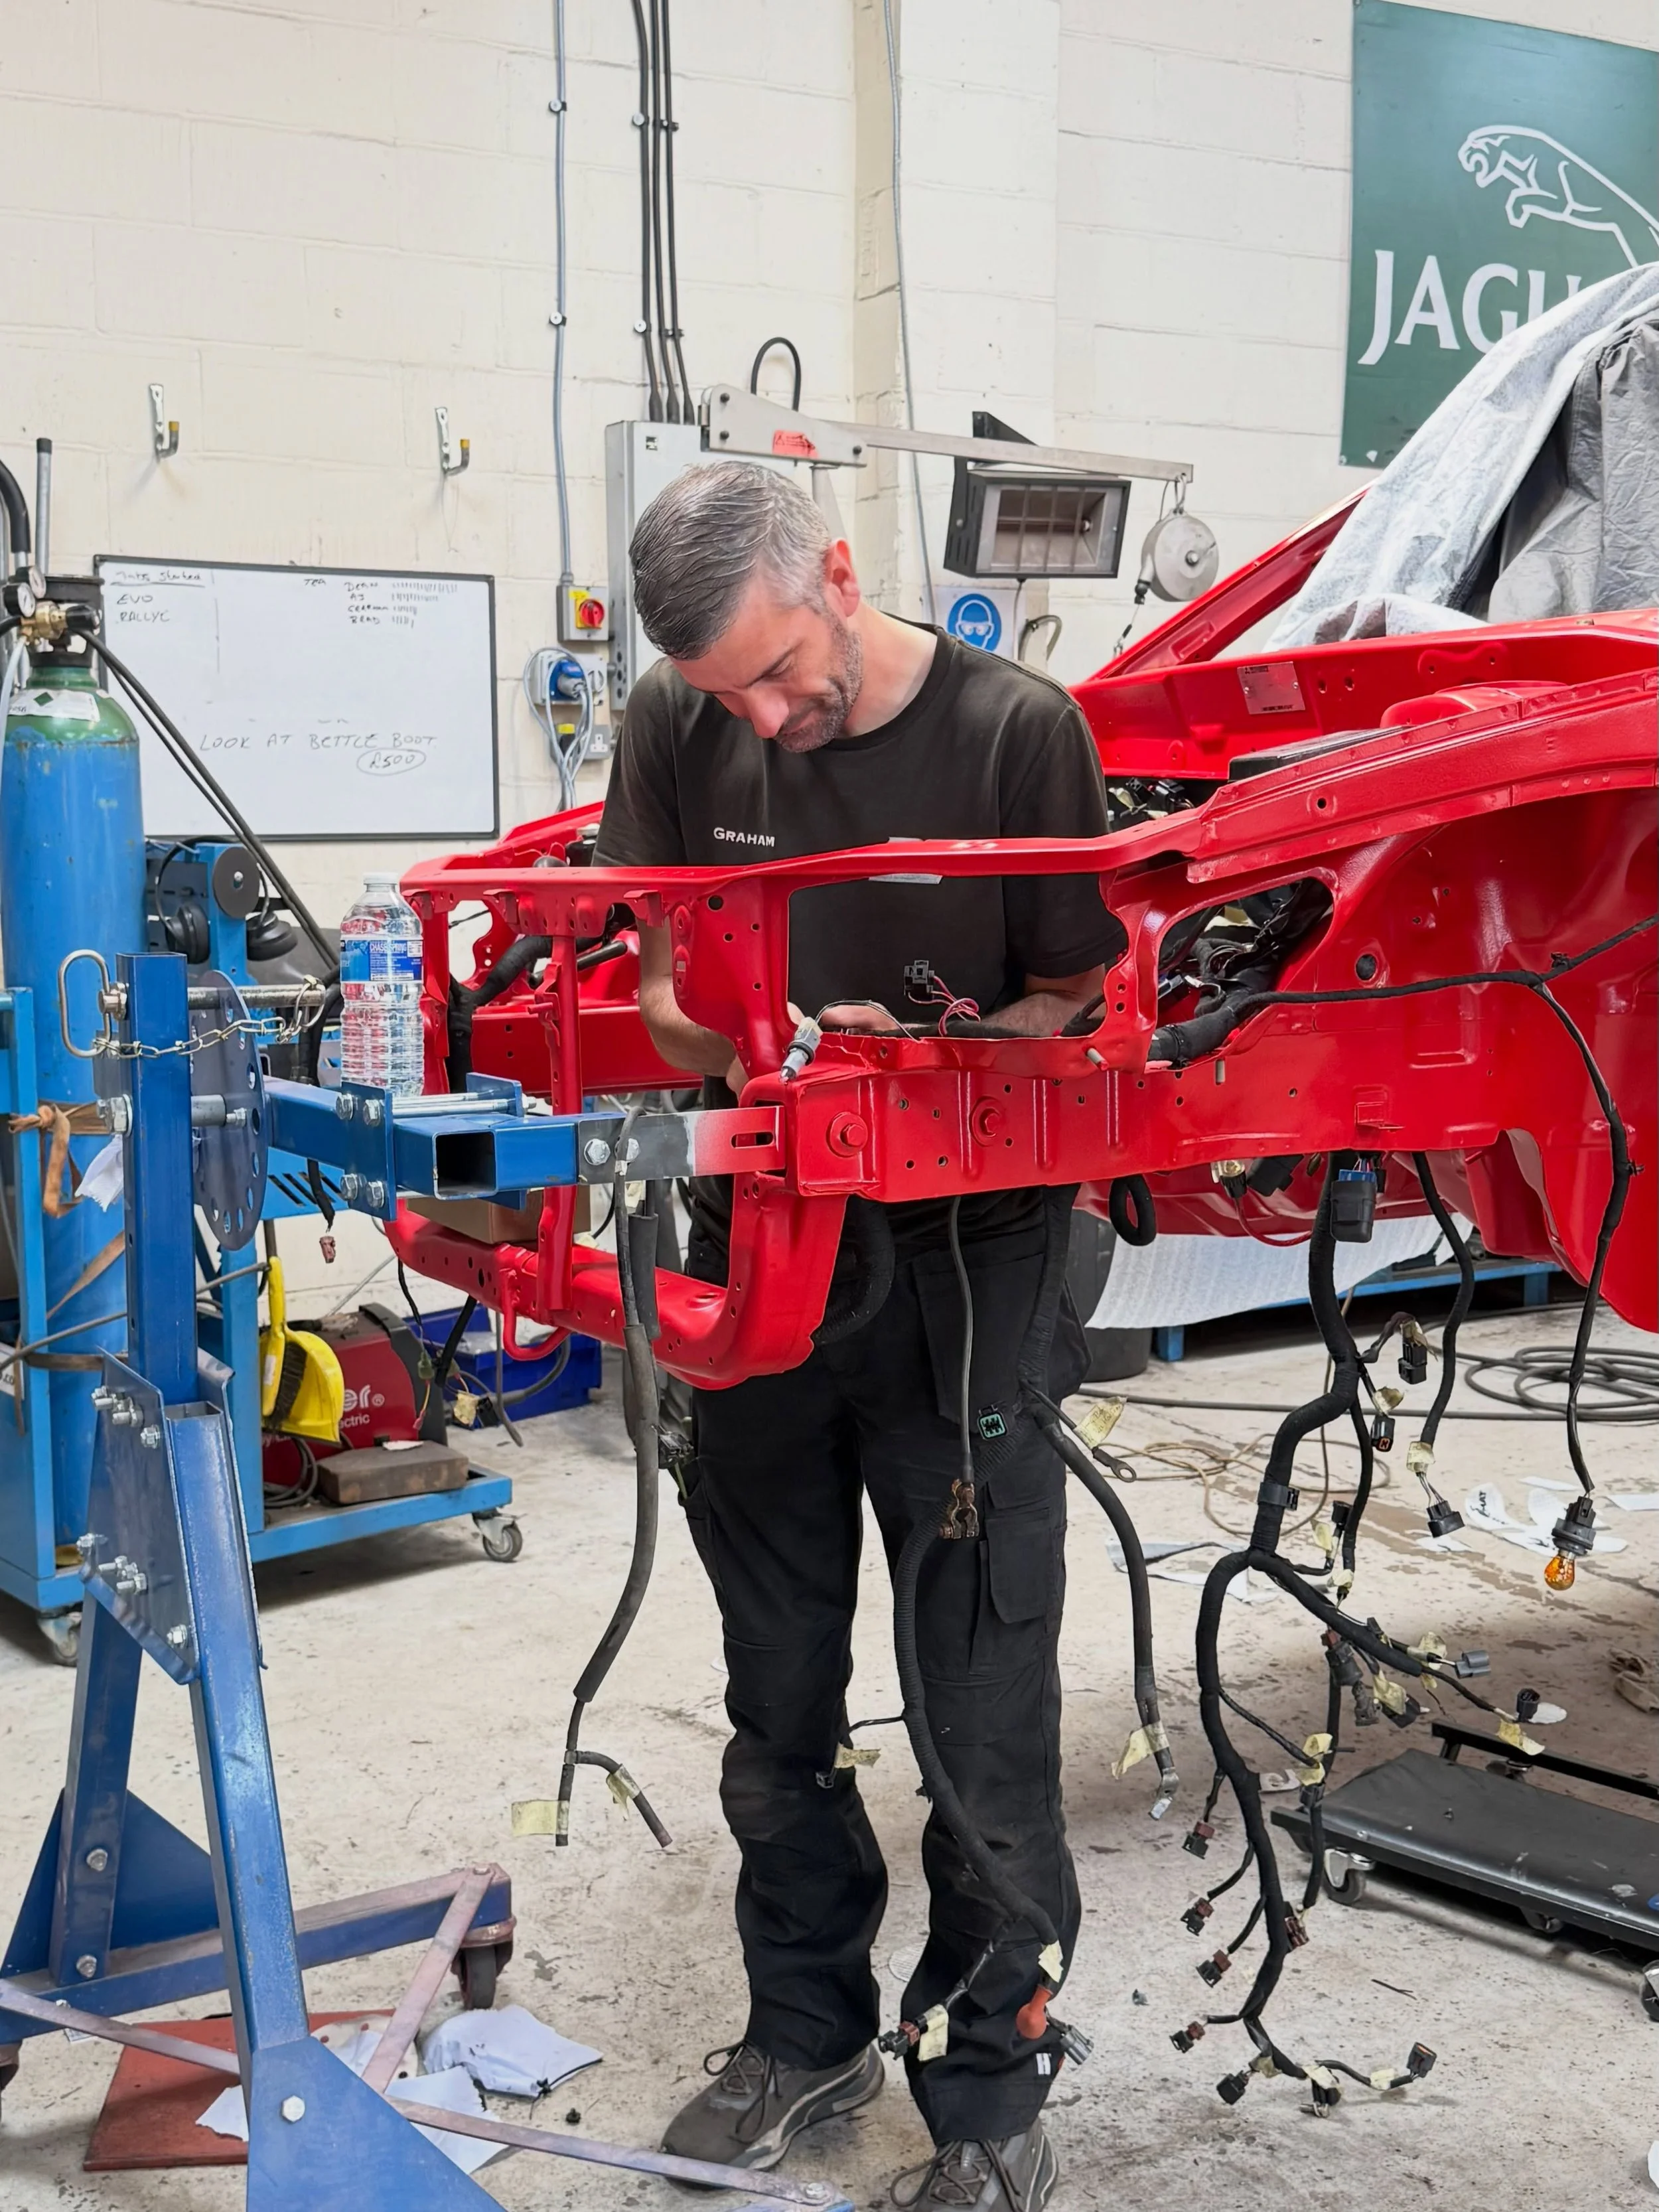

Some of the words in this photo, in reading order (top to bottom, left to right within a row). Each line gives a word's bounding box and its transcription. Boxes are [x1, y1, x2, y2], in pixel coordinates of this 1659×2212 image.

[117, 593, 153, 605] EVO
[200, 734, 251, 751] LOOK
[267, 734, 293, 747] AT
[713, 827, 775, 847] GRAHAM
